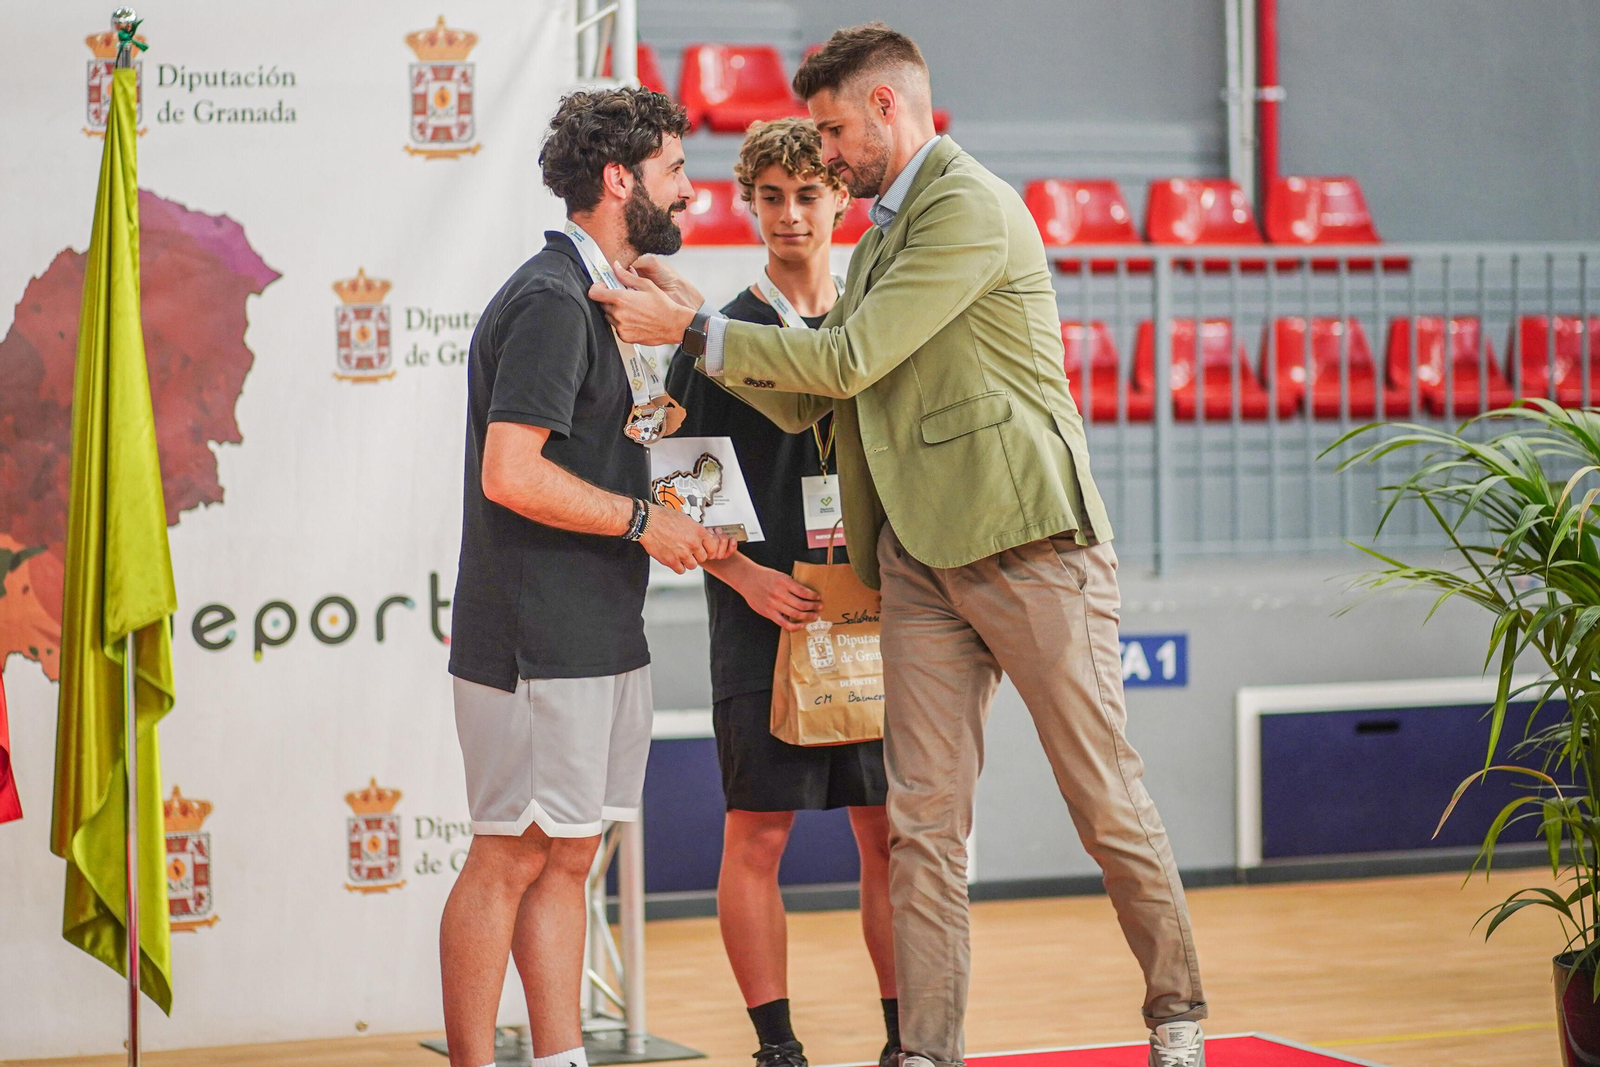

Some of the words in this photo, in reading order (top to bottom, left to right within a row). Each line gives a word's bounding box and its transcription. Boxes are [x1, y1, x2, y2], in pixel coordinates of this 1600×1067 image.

[157, 63, 296, 92] Diputación
[157, 99, 185, 123] de
[194, 99, 296, 123] Granada
[405, 343, 430, 366] de
[190, 571, 451, 662] eport
[841, 651, 853, 663] de
[1119, 640, 1152, 681] A
[1156, 640, 1177, 680] 1
[840, 677, 878, 688] DEPORTES
[814, 694, 832, 705] CM
[415, 851, 442, 874] de
